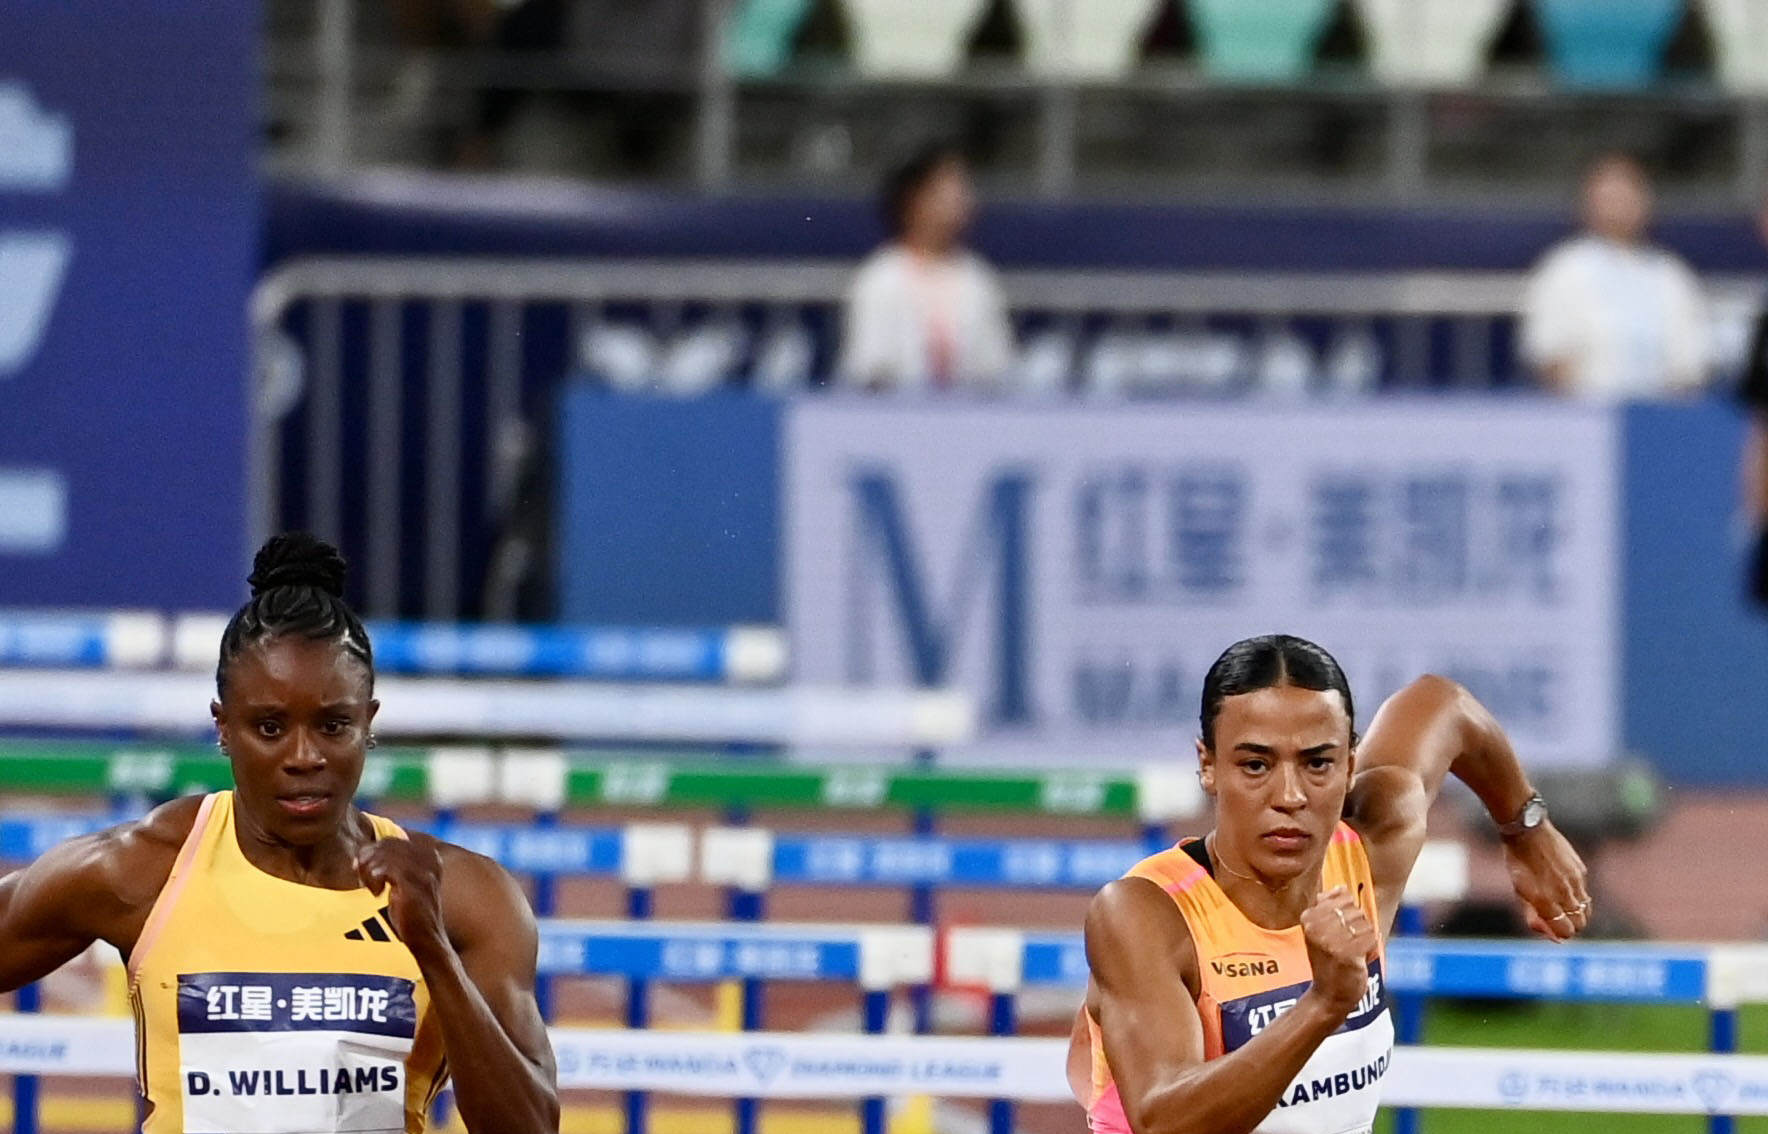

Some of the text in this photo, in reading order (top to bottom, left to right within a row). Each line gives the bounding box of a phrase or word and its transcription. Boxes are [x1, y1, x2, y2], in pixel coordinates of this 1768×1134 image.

[206, 985, 390, 1023] 红星·美凯龙
[187, 1066, 399, 1096] D. WILLIAMS
